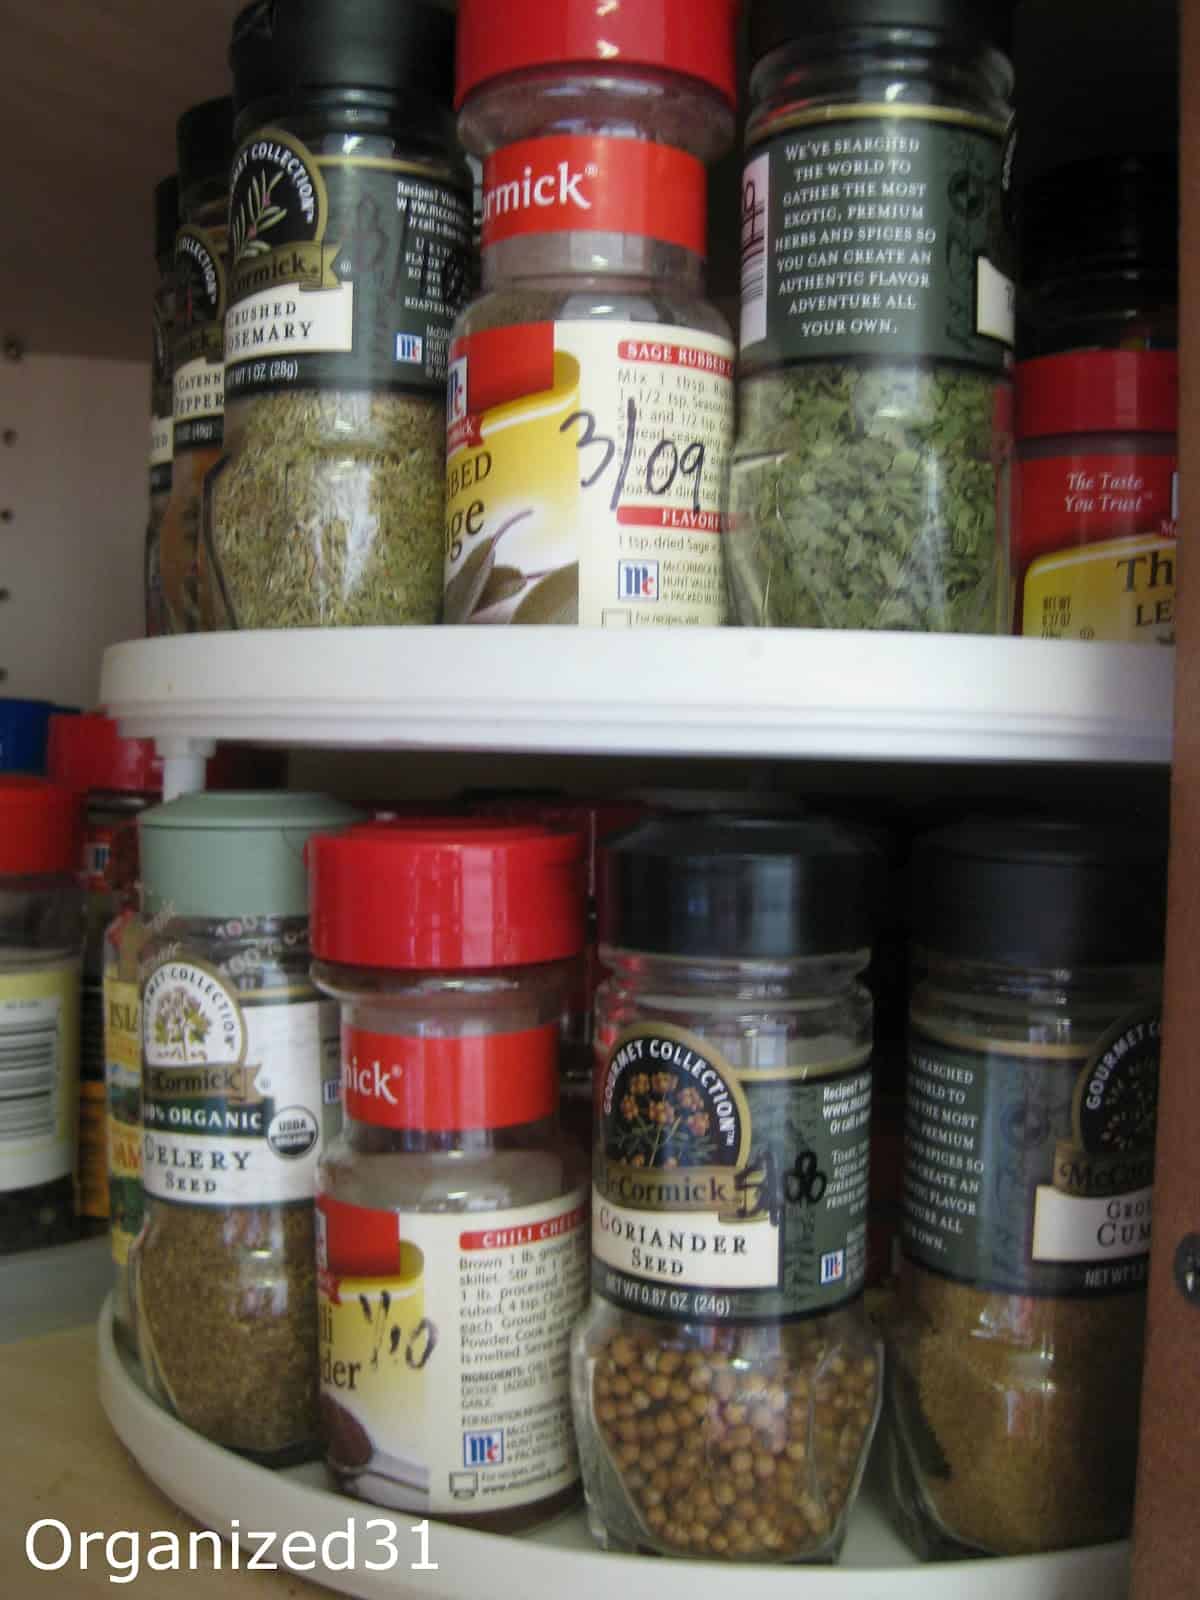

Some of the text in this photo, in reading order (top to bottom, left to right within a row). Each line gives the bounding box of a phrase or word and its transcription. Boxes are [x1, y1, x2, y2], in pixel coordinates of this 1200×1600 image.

[784, 135, 921, 161] WE'VE SEARCHED
[795, 159, 912, 183] THE WORLD TO
[783, 181, 927, 206] GATHER THE MOST
[784, 204, 925, 229] EXOTIC, PREMIUM
[775, 226, 937, 253] HERBS AND SPICES SO
[776, 249, 933, 274] YOU CAN CREATE AN
[778, 271, 931, 296] AUTHENTIC FLAVOR
[787, 294, 918, 316] ADVENTURE ALL
[228, 320, 313, 351] OSEMARY
[801, 318, 898, 338] YOUR OWN.
[626, 340, 672, 362] SAGE
[1066, 471, 1143, 492] The Taste
[1064, 493, 1143, 513] You Trust
[1135, 599, 1176, 627] LE
[603, 1041, 644, 1114] GOURMET
[1085, 1023, 1146, 1111] GOURMET
[947, 1089, 967, 1106] TO
[170, 1107, 263, 1130] ORGANIC
[941, 1109, 980, 1130] MOST
[959, 1178, 980, 1194] AN
[929, 1190, 977, 1217] FLAVOR
[482, 1225, 533, 1249] CHILI
[599, 1206, 748, 1256] CORIANDER
[694, 1294, 731, 1318] (24g)
